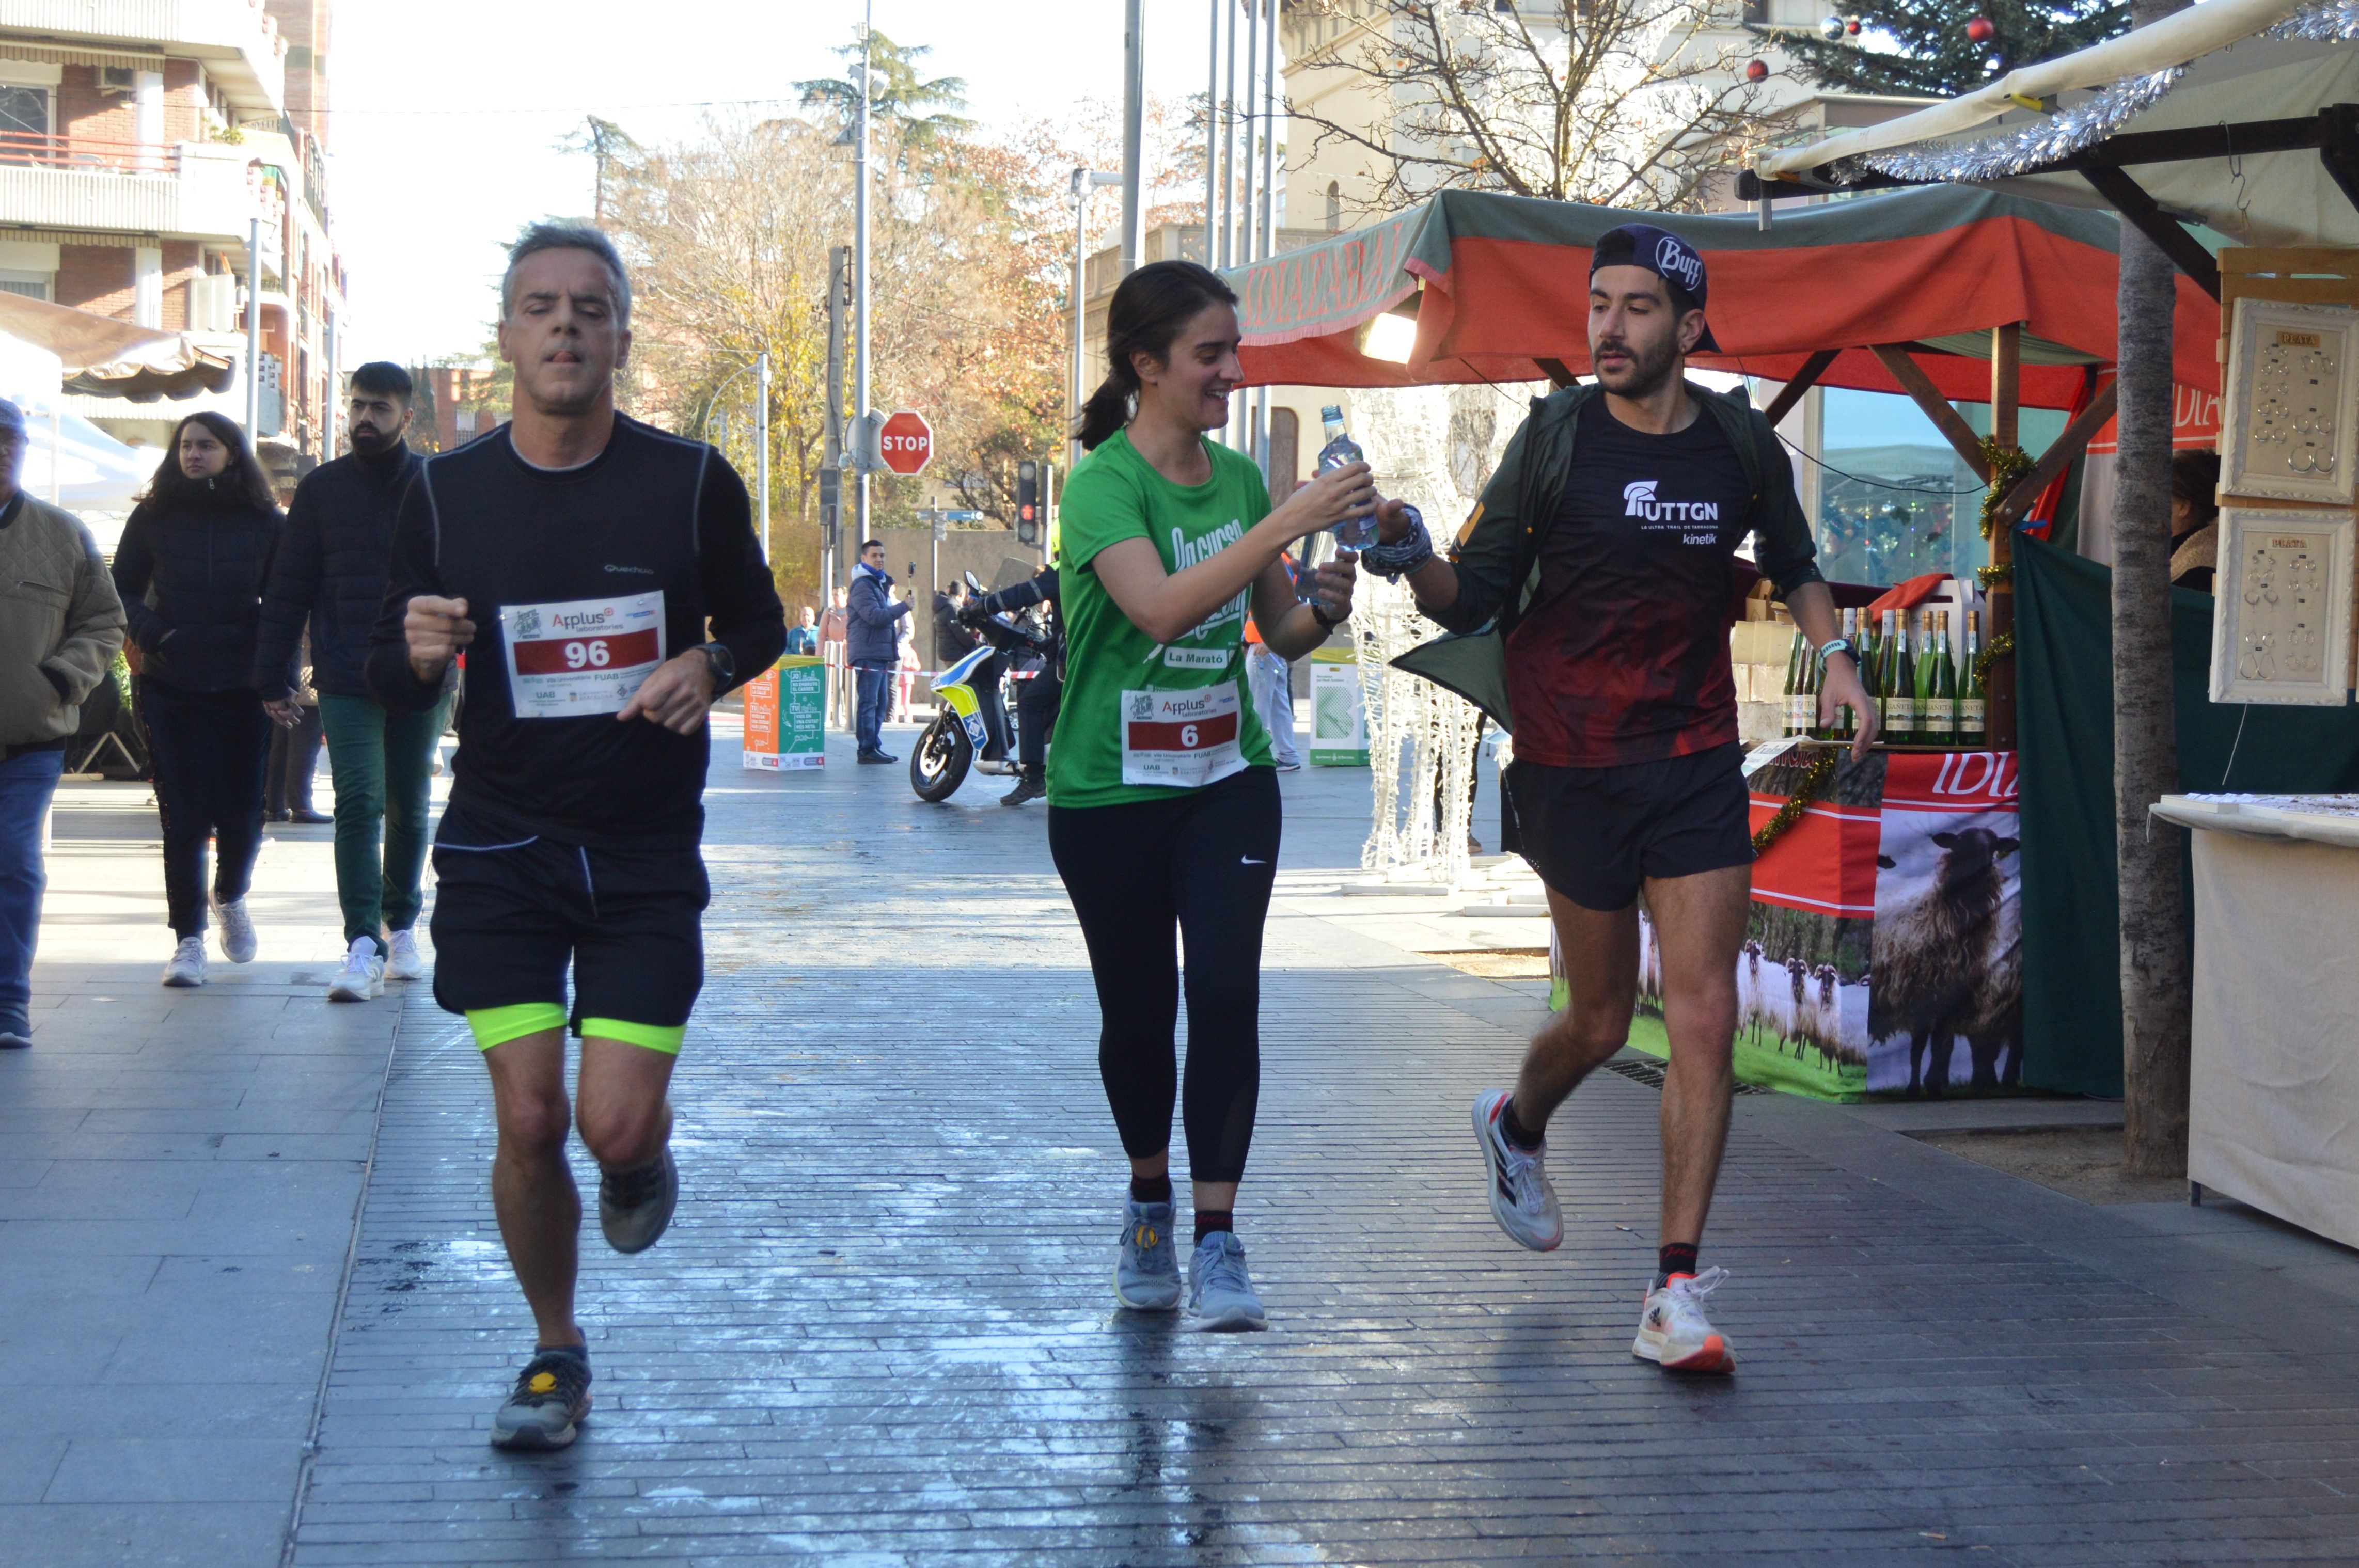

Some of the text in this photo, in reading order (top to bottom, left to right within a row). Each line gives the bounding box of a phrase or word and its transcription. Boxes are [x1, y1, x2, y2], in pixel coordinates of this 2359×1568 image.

[2283, 334, 2315, 344] PLATA
[883, 435, 927, 451] STOP
[1645, 502, 1718, 521] UTTGN
[1682, 534, 1717, 545] kinetik
[2272, 538, 2308, 549] PLATA
[576, 622, 624, 633] laboratories
[565, 640, 610, 668] 96
[1169, 652, 1223, 663] La Marató
[1182, 709, 1217, 717] laboratories
[1181, 724, 1199, 747] 6
[1194, 751, 1211, 759] FUAB
